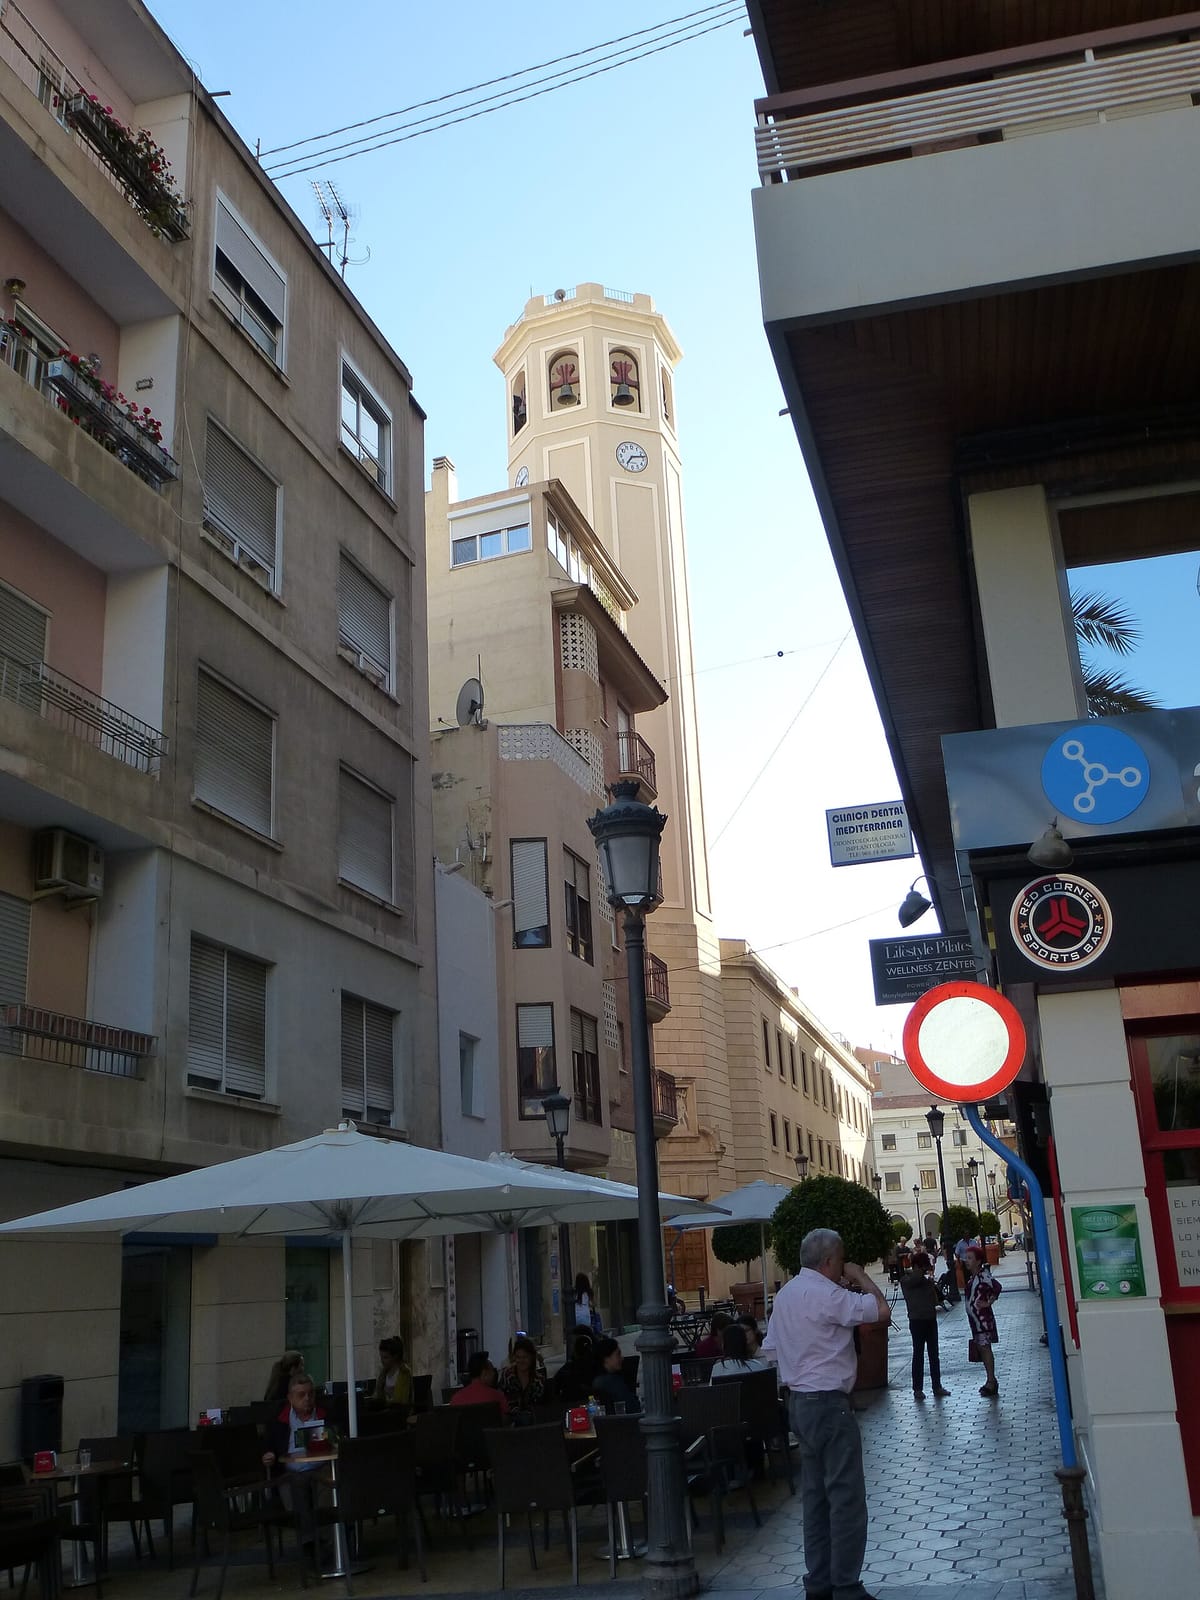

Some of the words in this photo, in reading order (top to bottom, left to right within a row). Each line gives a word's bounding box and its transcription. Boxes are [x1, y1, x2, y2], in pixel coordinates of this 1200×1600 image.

[832, 811, 869, 823] CLINICA
[871, 806, 904, 818] DENTAL
[835, 819, 903, 836] MEDITERRANEA
[1020, 891, 1039, 917] RED
[1043, 882, 1099, 910] CORNER
[885, 942, 934, 960] Lifestyle
[936, 940, 972, 954] Pilates
[1023, 934, 1080, 962] SPORTS
[1084, 925, 1103, 954] BAR
[886, 963, 933, 976] WELLNESS
[935, 959, 976, 971] ZENTER
[1174, 1200, 1188, 1209] EL
[1178, 1233, 1192, 1242] LO
[1181, 1250, 1194, 1258] EL
